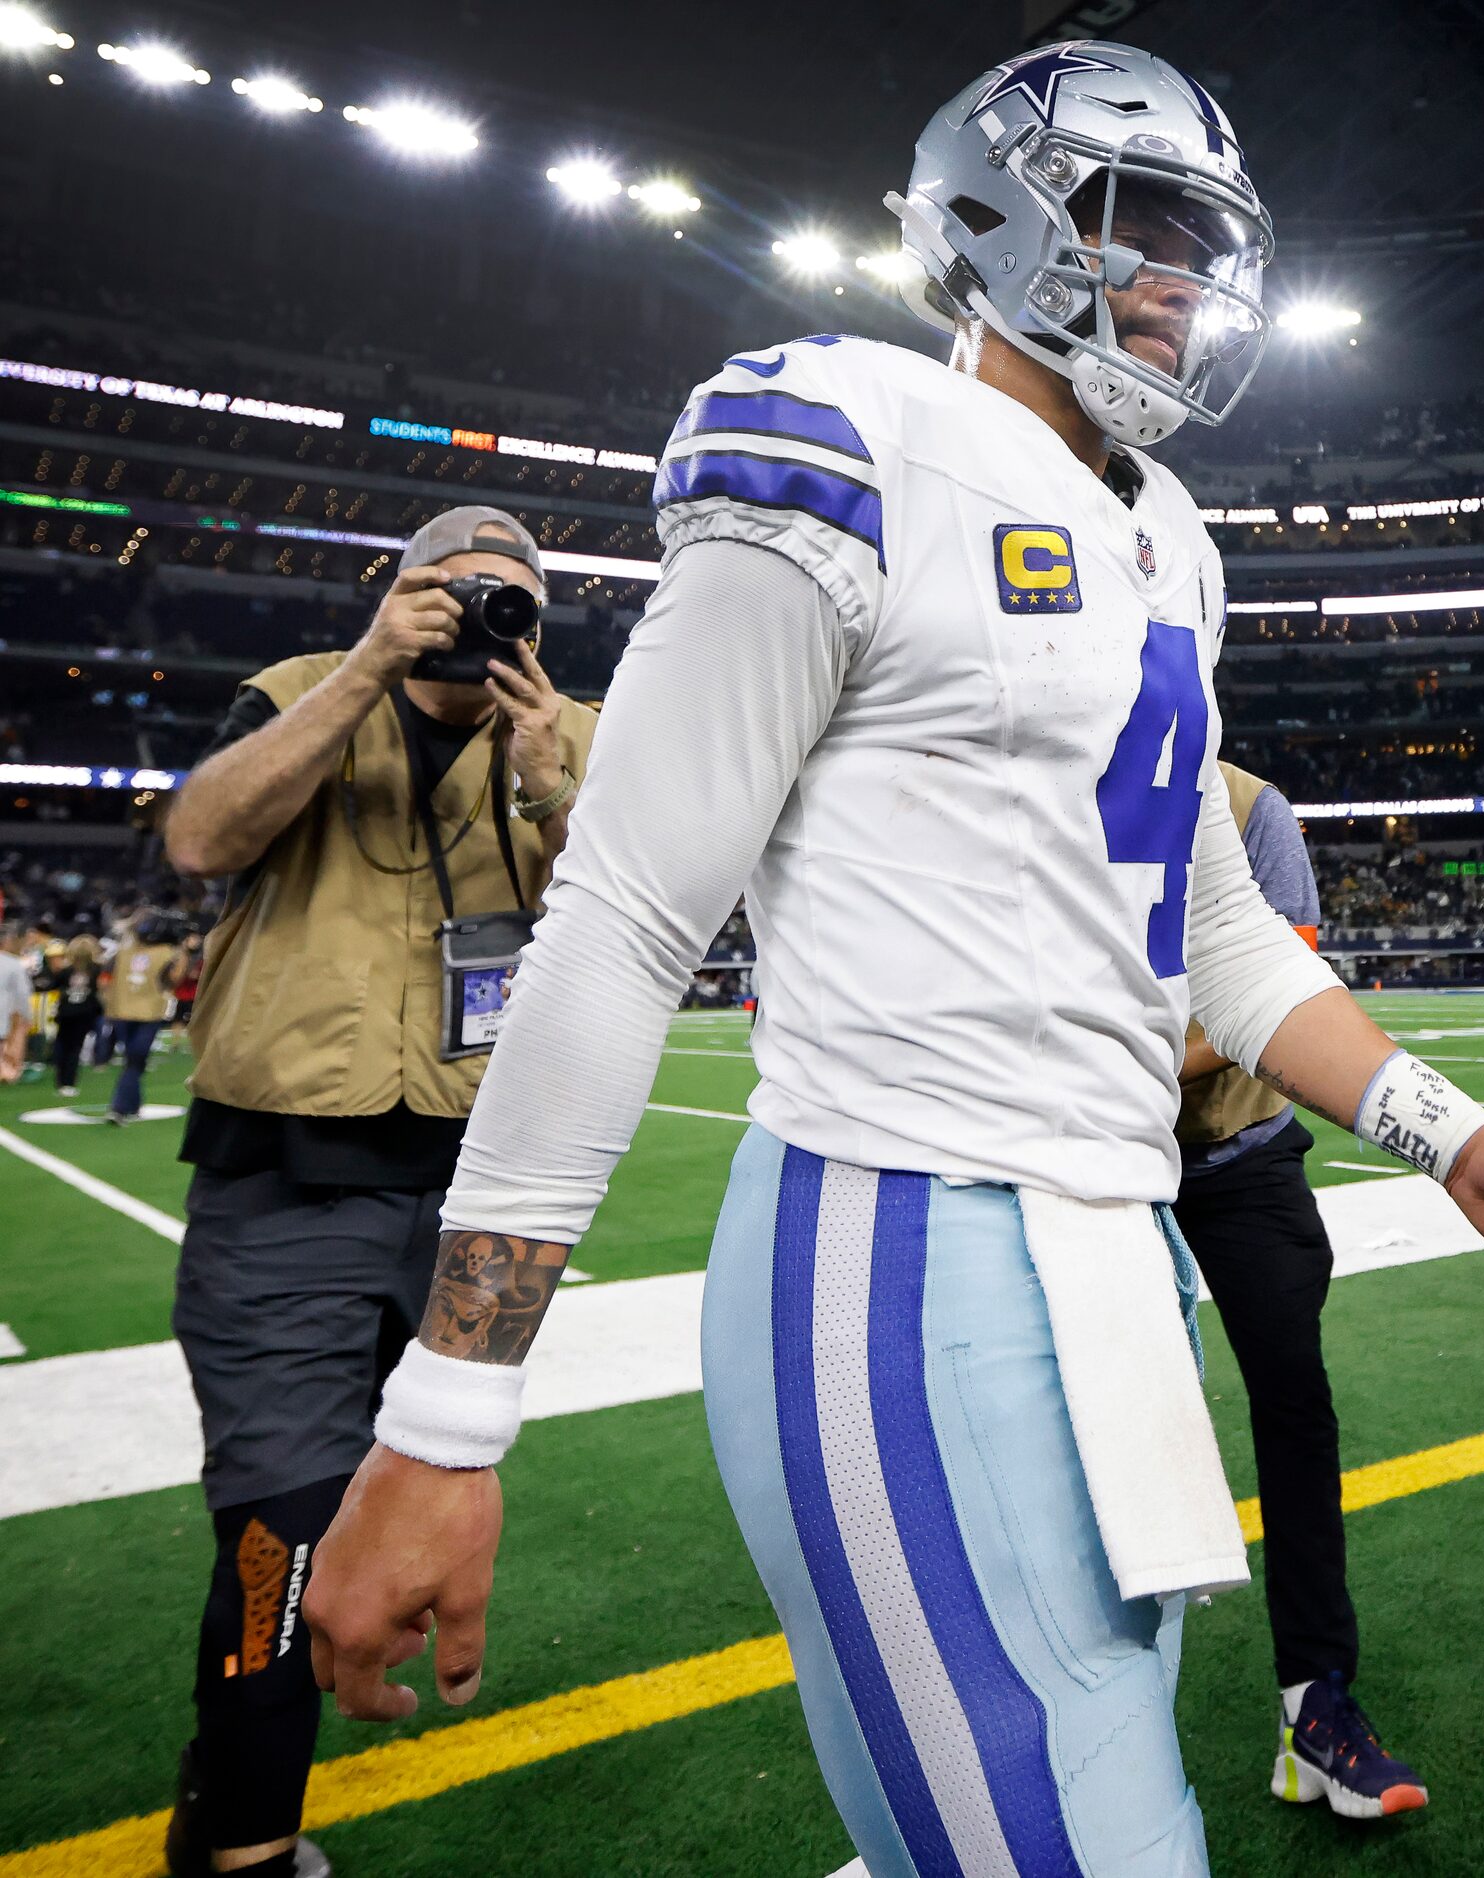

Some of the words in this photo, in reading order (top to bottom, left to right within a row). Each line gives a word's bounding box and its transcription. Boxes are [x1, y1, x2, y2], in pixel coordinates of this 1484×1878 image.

[370, 417, 451, 446] STUDENTS
[1460, 498, 1481, 513] OF
[1003, 530, 1073, 589] C
[1096, 617, 1208, 979] 4
[1374, 1111, 1438, 1170] FAITH
[277, 1543, 309, 1658] ENDURA
